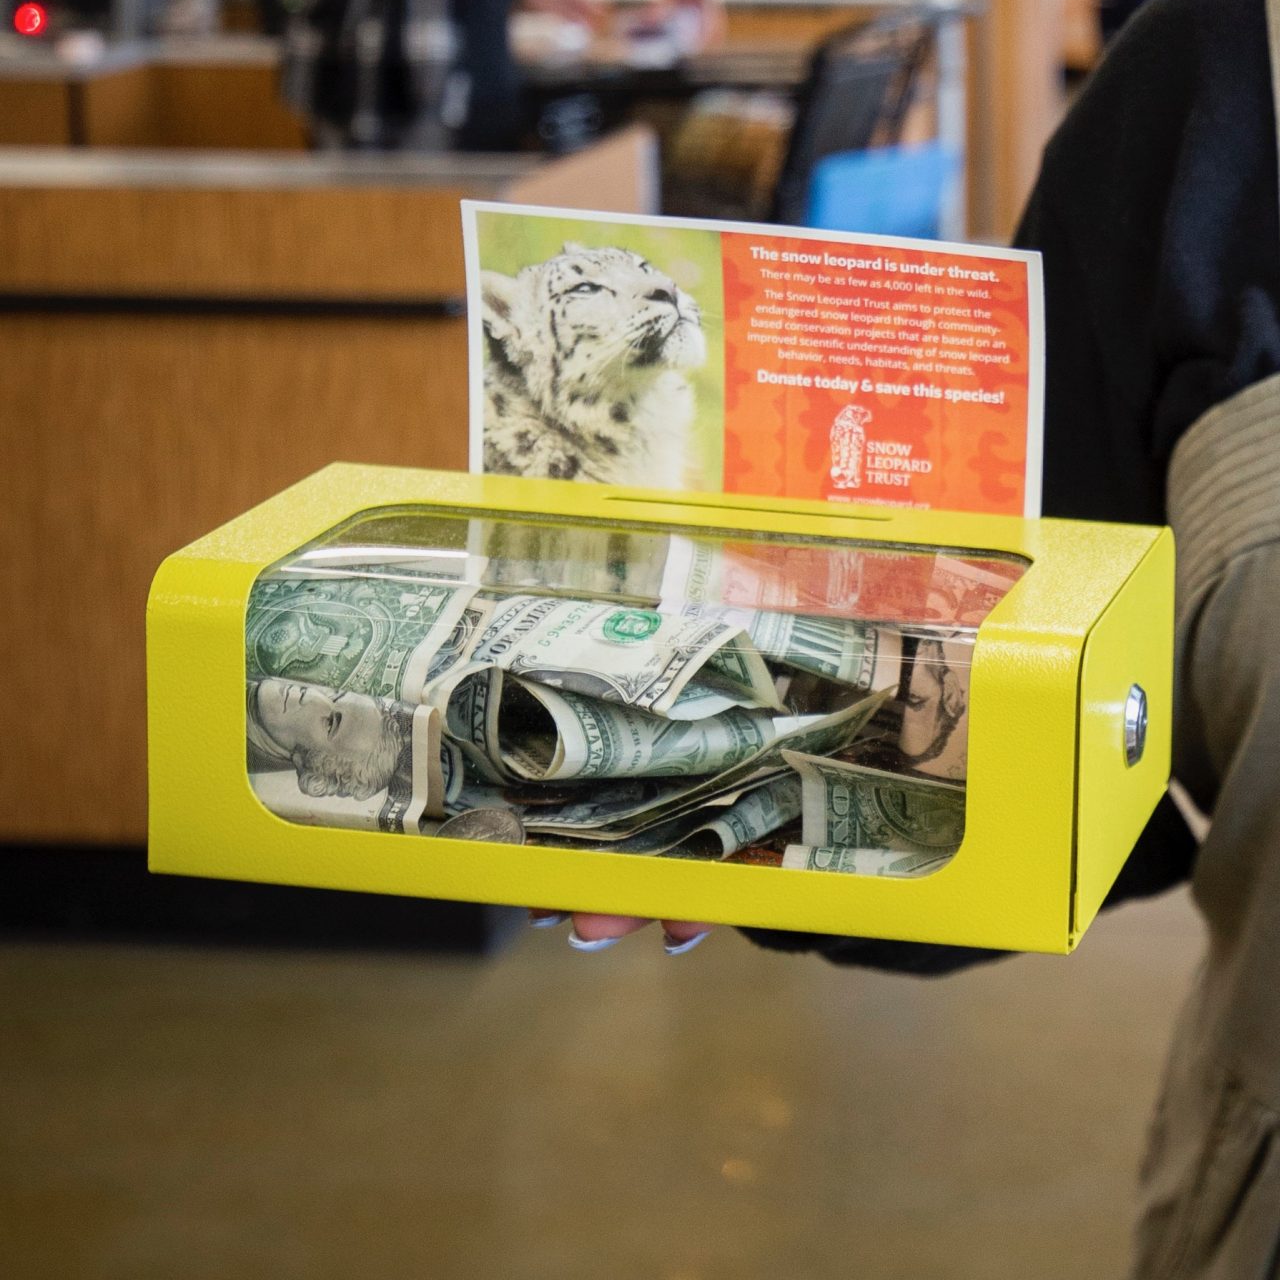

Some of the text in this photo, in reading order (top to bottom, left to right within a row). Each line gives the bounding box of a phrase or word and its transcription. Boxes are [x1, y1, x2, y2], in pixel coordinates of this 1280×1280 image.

[750, 247, 999, 282] The snow leopard is under threat.
[760, 269, 990, 299] There may be as few as 4,000 left in the wild.
[764, 289, 991, 318] The Snow Leopard Trust aims to protect the
[751, 318, 1005, 348] based conservation projects that are based on an
[756, 304, 1001, 335] endangered snow leopard through community-
[748, 332, 1009, 365] improved scientific understanding of snow leopard
[778, 349, 975, 375] behavior, needs, habitats, and threats.
[757, 370, 1004, 404] Donate today & save this species!
[867, 441, 912, 456] SNOW
[866, 456, 932, 473] LEOPARD
[866, 471, 910, 486] TRUST
